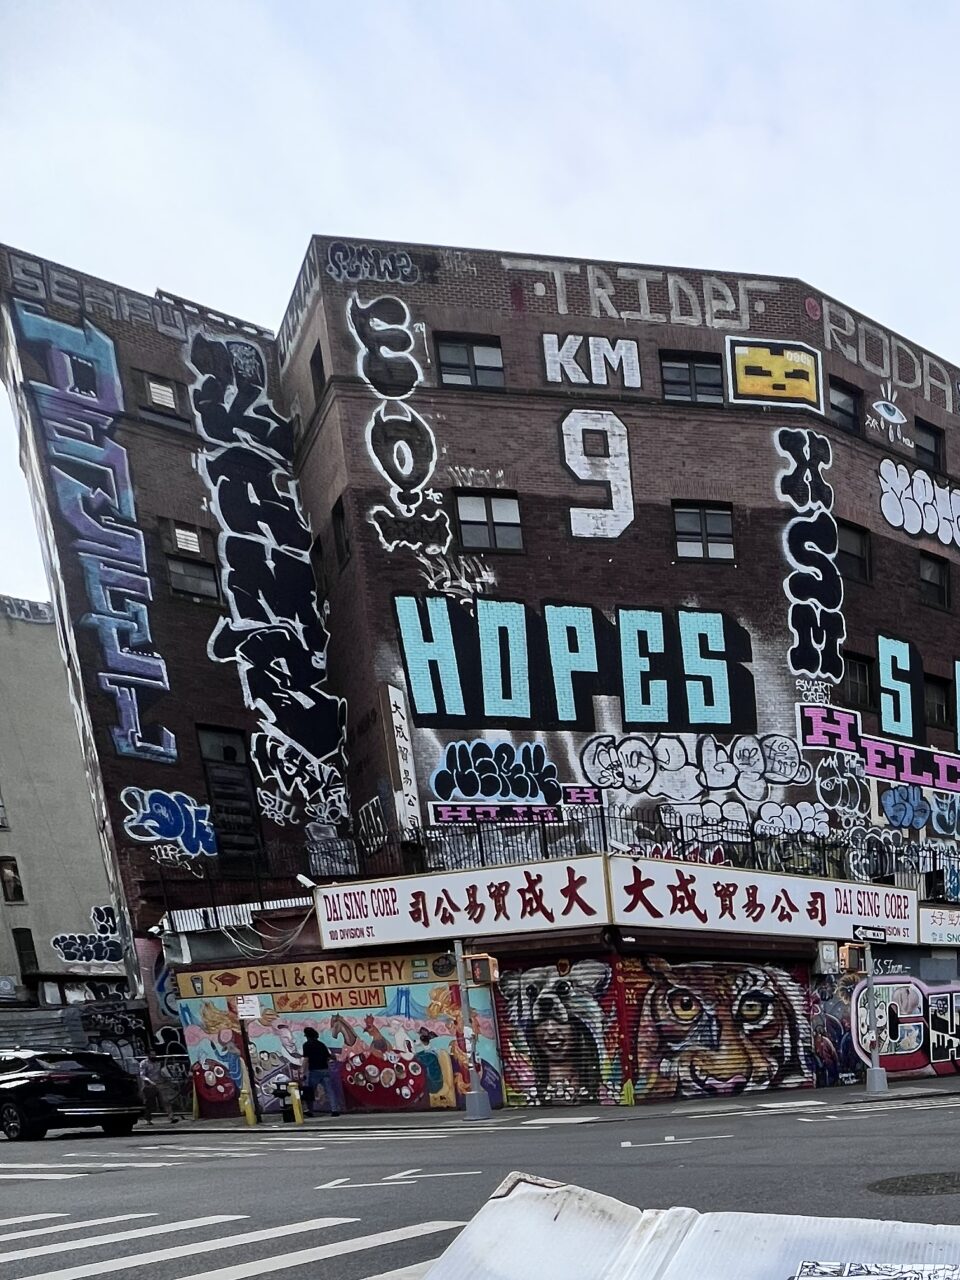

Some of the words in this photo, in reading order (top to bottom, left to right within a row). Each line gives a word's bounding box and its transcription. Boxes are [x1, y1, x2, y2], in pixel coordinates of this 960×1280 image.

[541, 333, 642, 389] KM
[822, 298, 953, 413] RODA
[561, 408, 635, 539] 9
[395, 595, 732, 725] HOPES
[795, 678, 833, 694] SMART
[802, 691, 832, 706] CREW
[323, 893, 343, 922] DAI
[343, 891, 369, 921] SING
[370, 887, 399, 918] CORP.
[623, 865, 827, 927] 大成貿易公司
[835, 887, 853, 915] DAI
[857, 889, 880, 918] SING
[884, 894, 910, 921] CORP.
[340, 928, 365, 940] DIVISION
[247, 971, 288, 989] DELI
[294, 969, 306, 986] &
[312, 960, 405, 984] GROCERY
[312, 991, 342, 1009] DIM
[350, 989, 380, 1006] SUM
